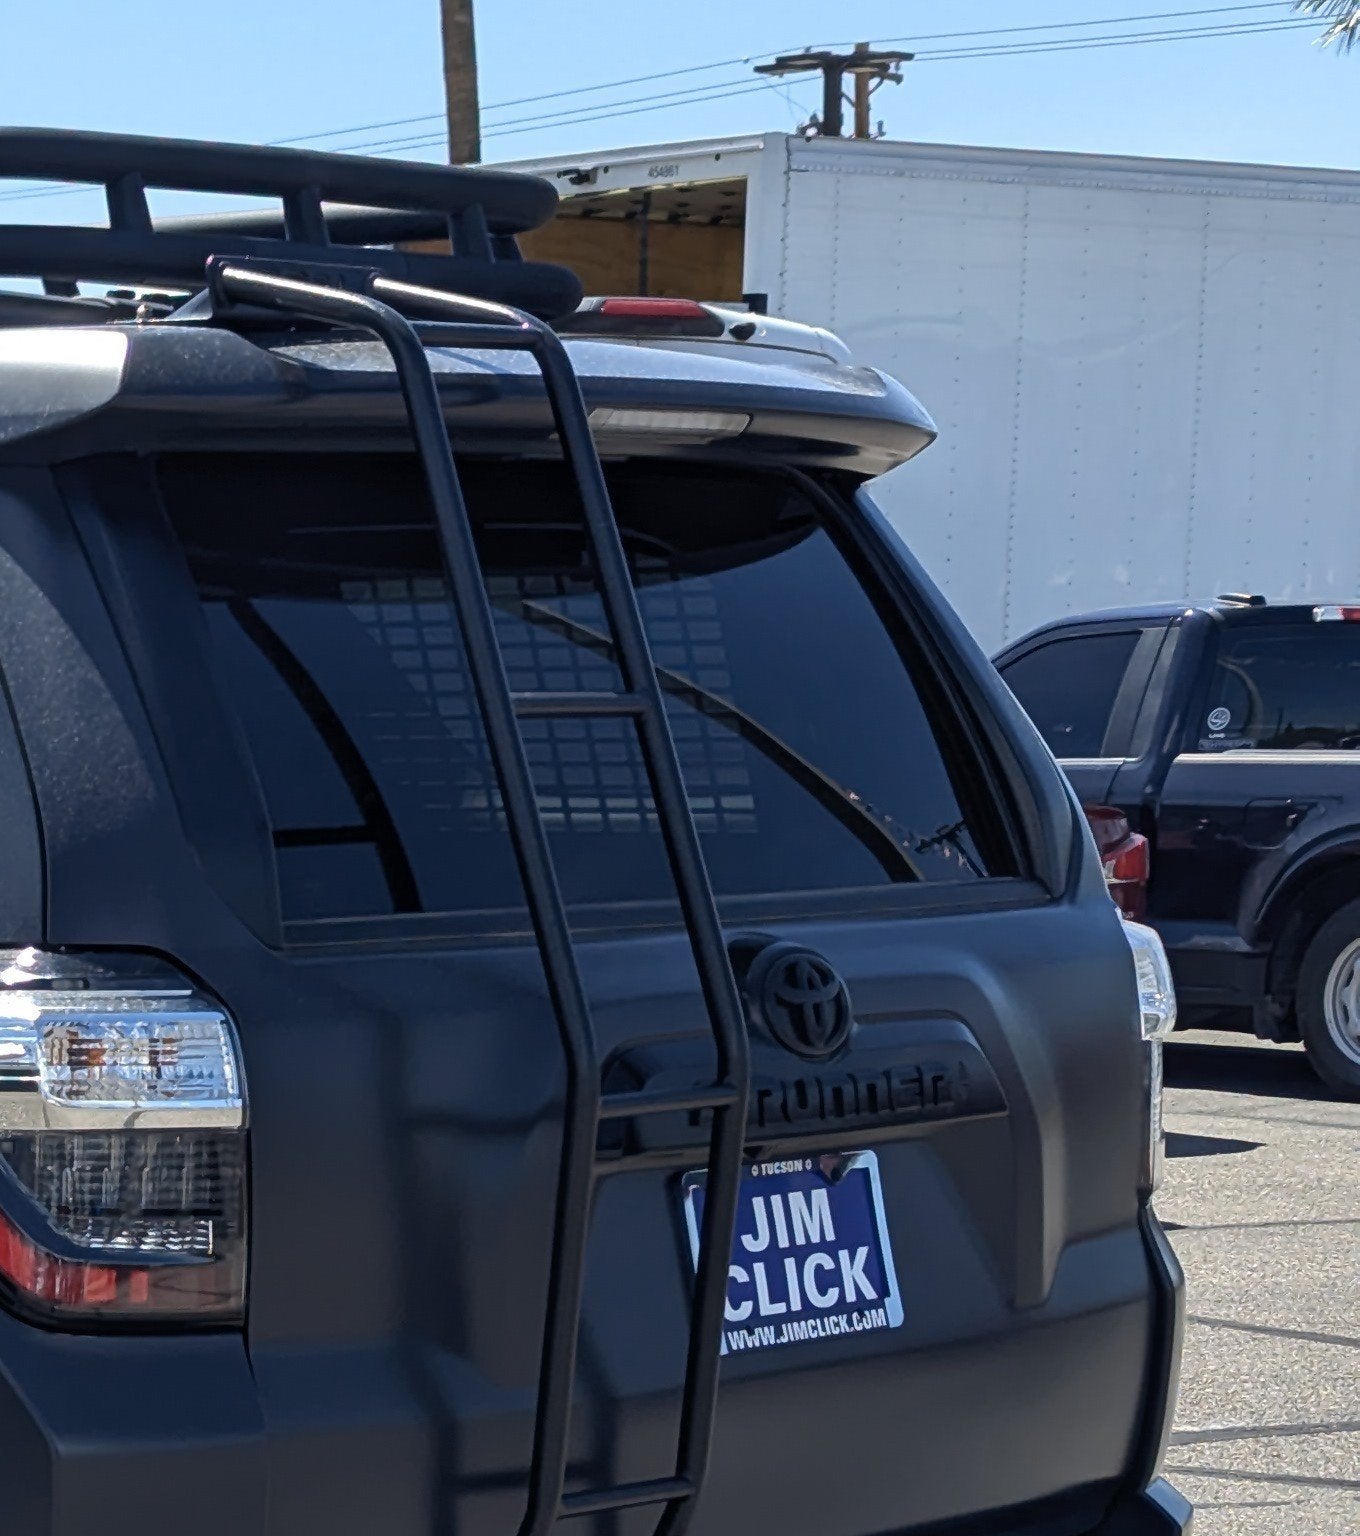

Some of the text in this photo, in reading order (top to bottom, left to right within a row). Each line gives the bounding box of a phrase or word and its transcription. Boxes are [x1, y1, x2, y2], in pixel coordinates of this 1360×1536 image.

[760, 1158, 803, 1176] TUCSON
[740, 1187, 836, 1253] JIM
[723, 1245, 879, 1322] CLICK
[727, 1307, 888, 1351] WWW.JIMCLICK.COM
